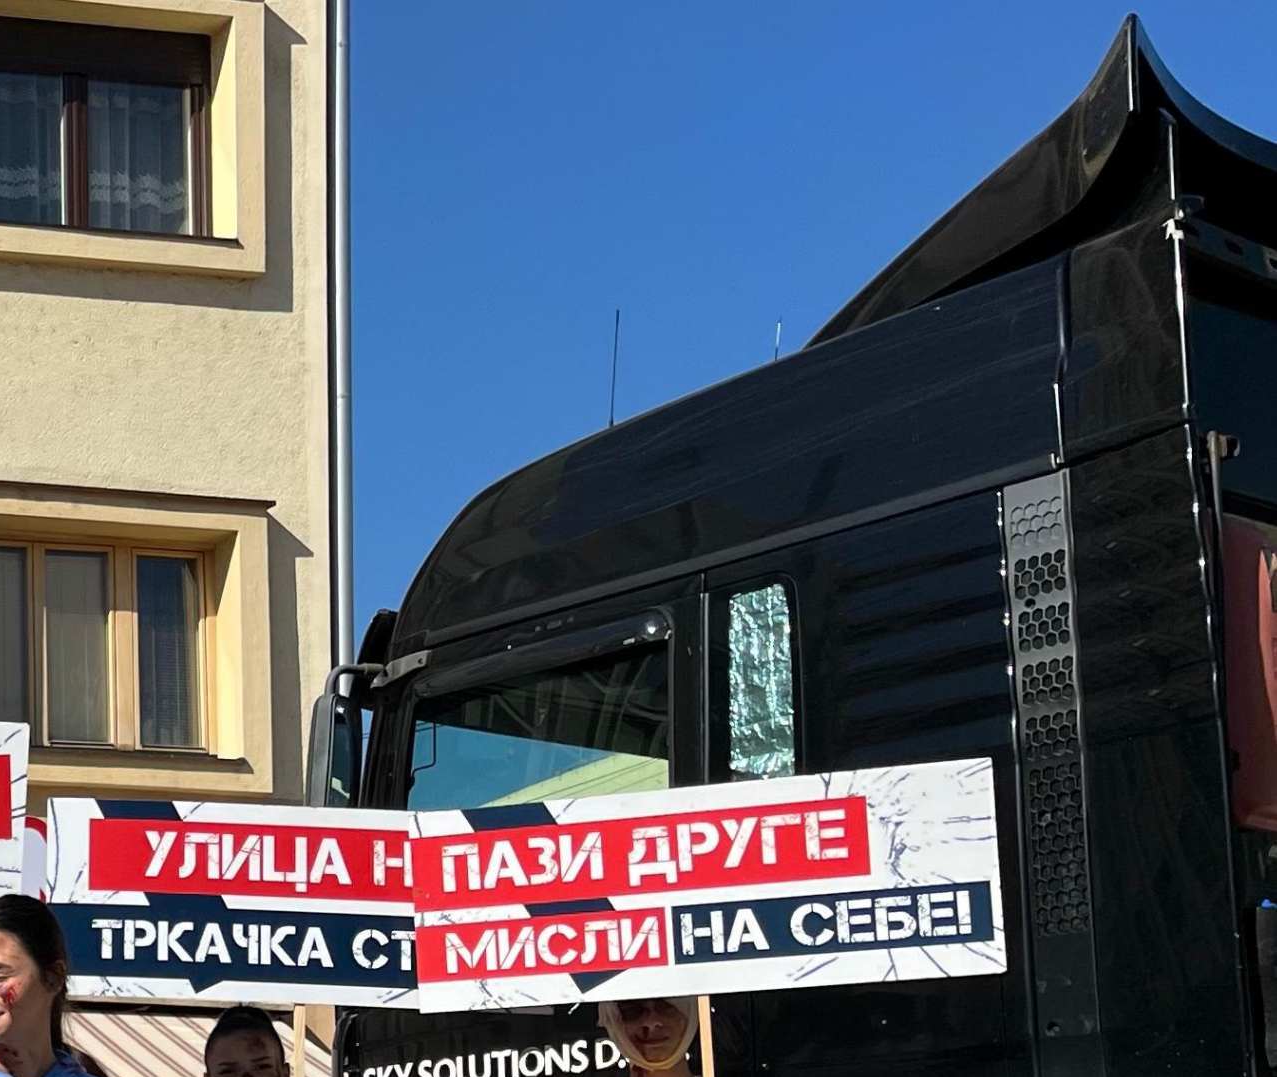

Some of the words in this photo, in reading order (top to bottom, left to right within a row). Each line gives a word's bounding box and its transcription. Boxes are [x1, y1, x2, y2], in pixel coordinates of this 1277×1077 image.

[144, 830, 352, 893] УЛИЦА
[442, 831, 603, 893] ПАЗИ
[628, 808, 848, 887] ДРУГЕ
[91, 919, 334, 968] ТРКАЧКА
[446, 914, 660, 974] МИСЛИ
[681, 905, 769, 956] НА
[790, 889, 973, 948] СЕБЕ!
[596, 1039, 630, 1070] D.
